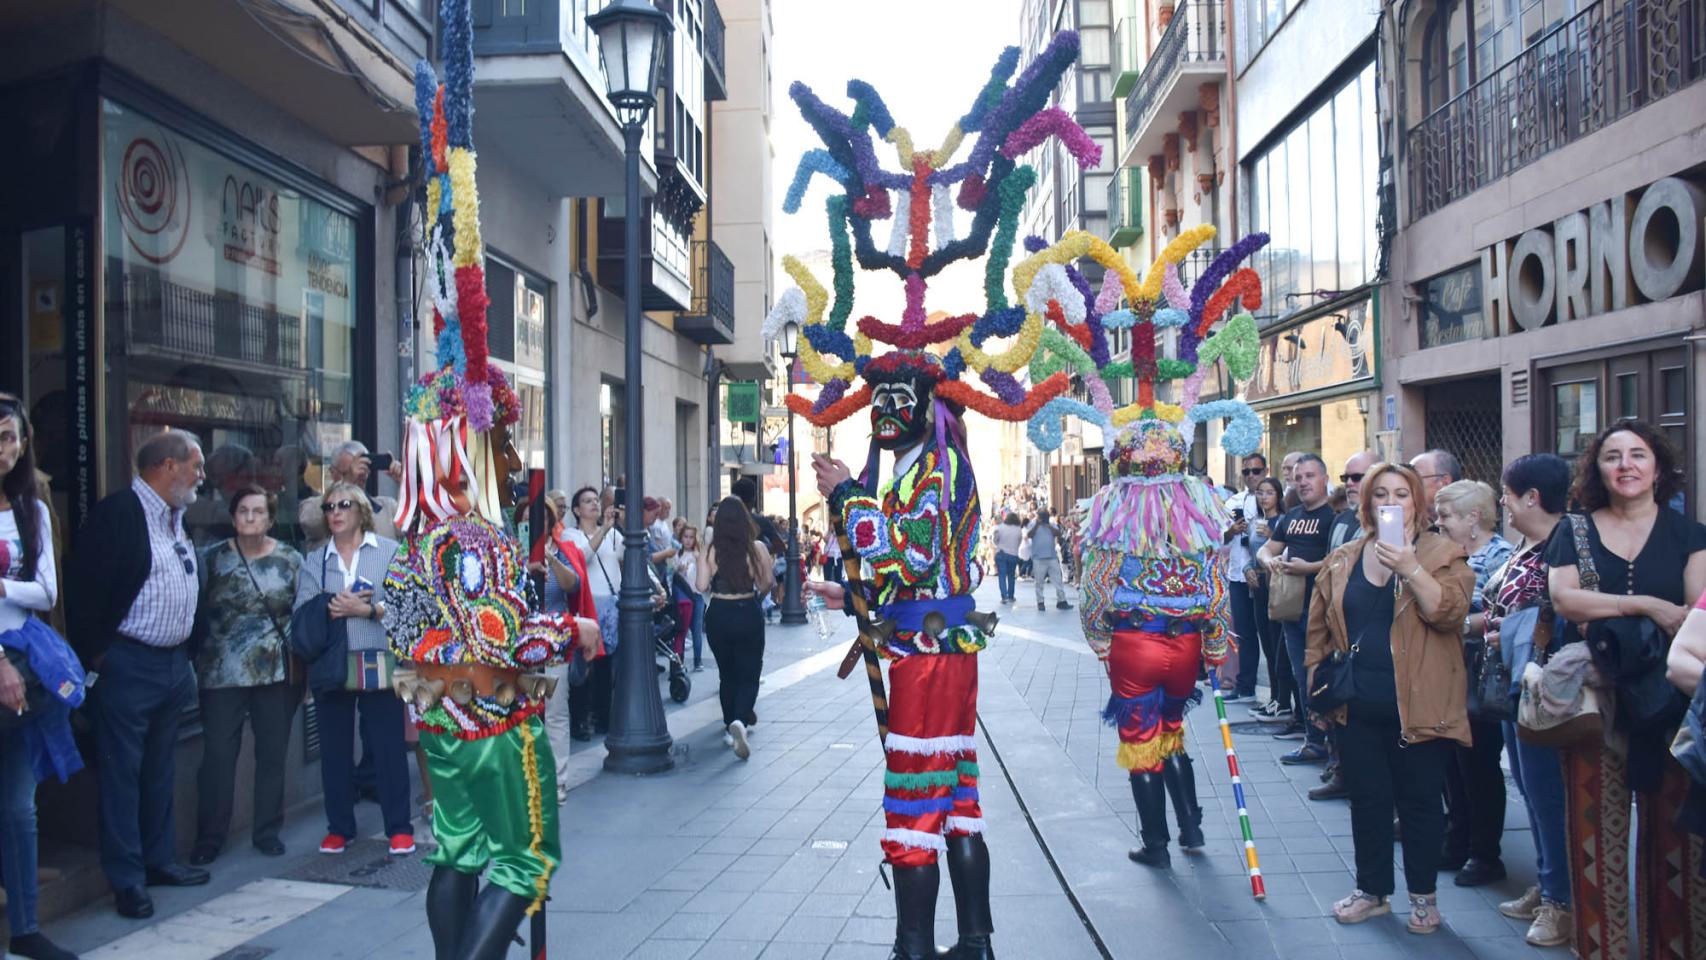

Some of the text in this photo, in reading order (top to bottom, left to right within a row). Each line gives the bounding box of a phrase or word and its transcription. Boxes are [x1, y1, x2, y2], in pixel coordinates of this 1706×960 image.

[75, 228, 85, 279] casa?
[1480, 177, 1697, 341] HORNO
[77, 284, 86, 304] en
[75, 310, 86, 350] uñas
[77, 356, 86, 381] las
[77, 386, 88, 440] pintas
[78, 444, 87, 461] te
[1286, 518, 1320, 535] RAW.
